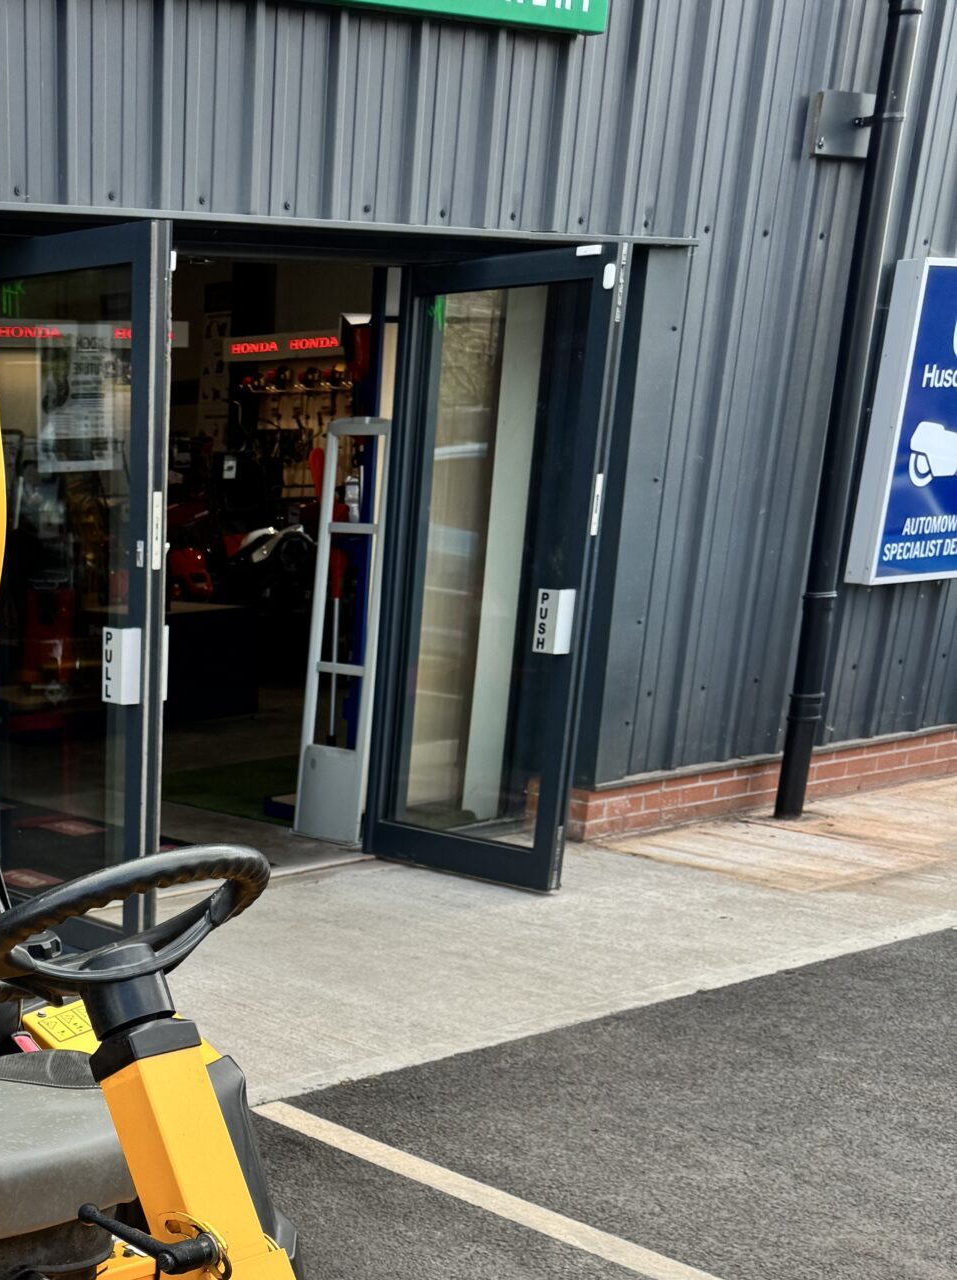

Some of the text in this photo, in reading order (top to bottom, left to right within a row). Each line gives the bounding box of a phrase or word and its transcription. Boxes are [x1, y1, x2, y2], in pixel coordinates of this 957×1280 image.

[231, 336, 339, 354] HONDA HONDA
[882, 540, 943, 561] SPECIALIST
[536, 592, 549, 650] PUSH
[105, 631, 113, 698] PULL
